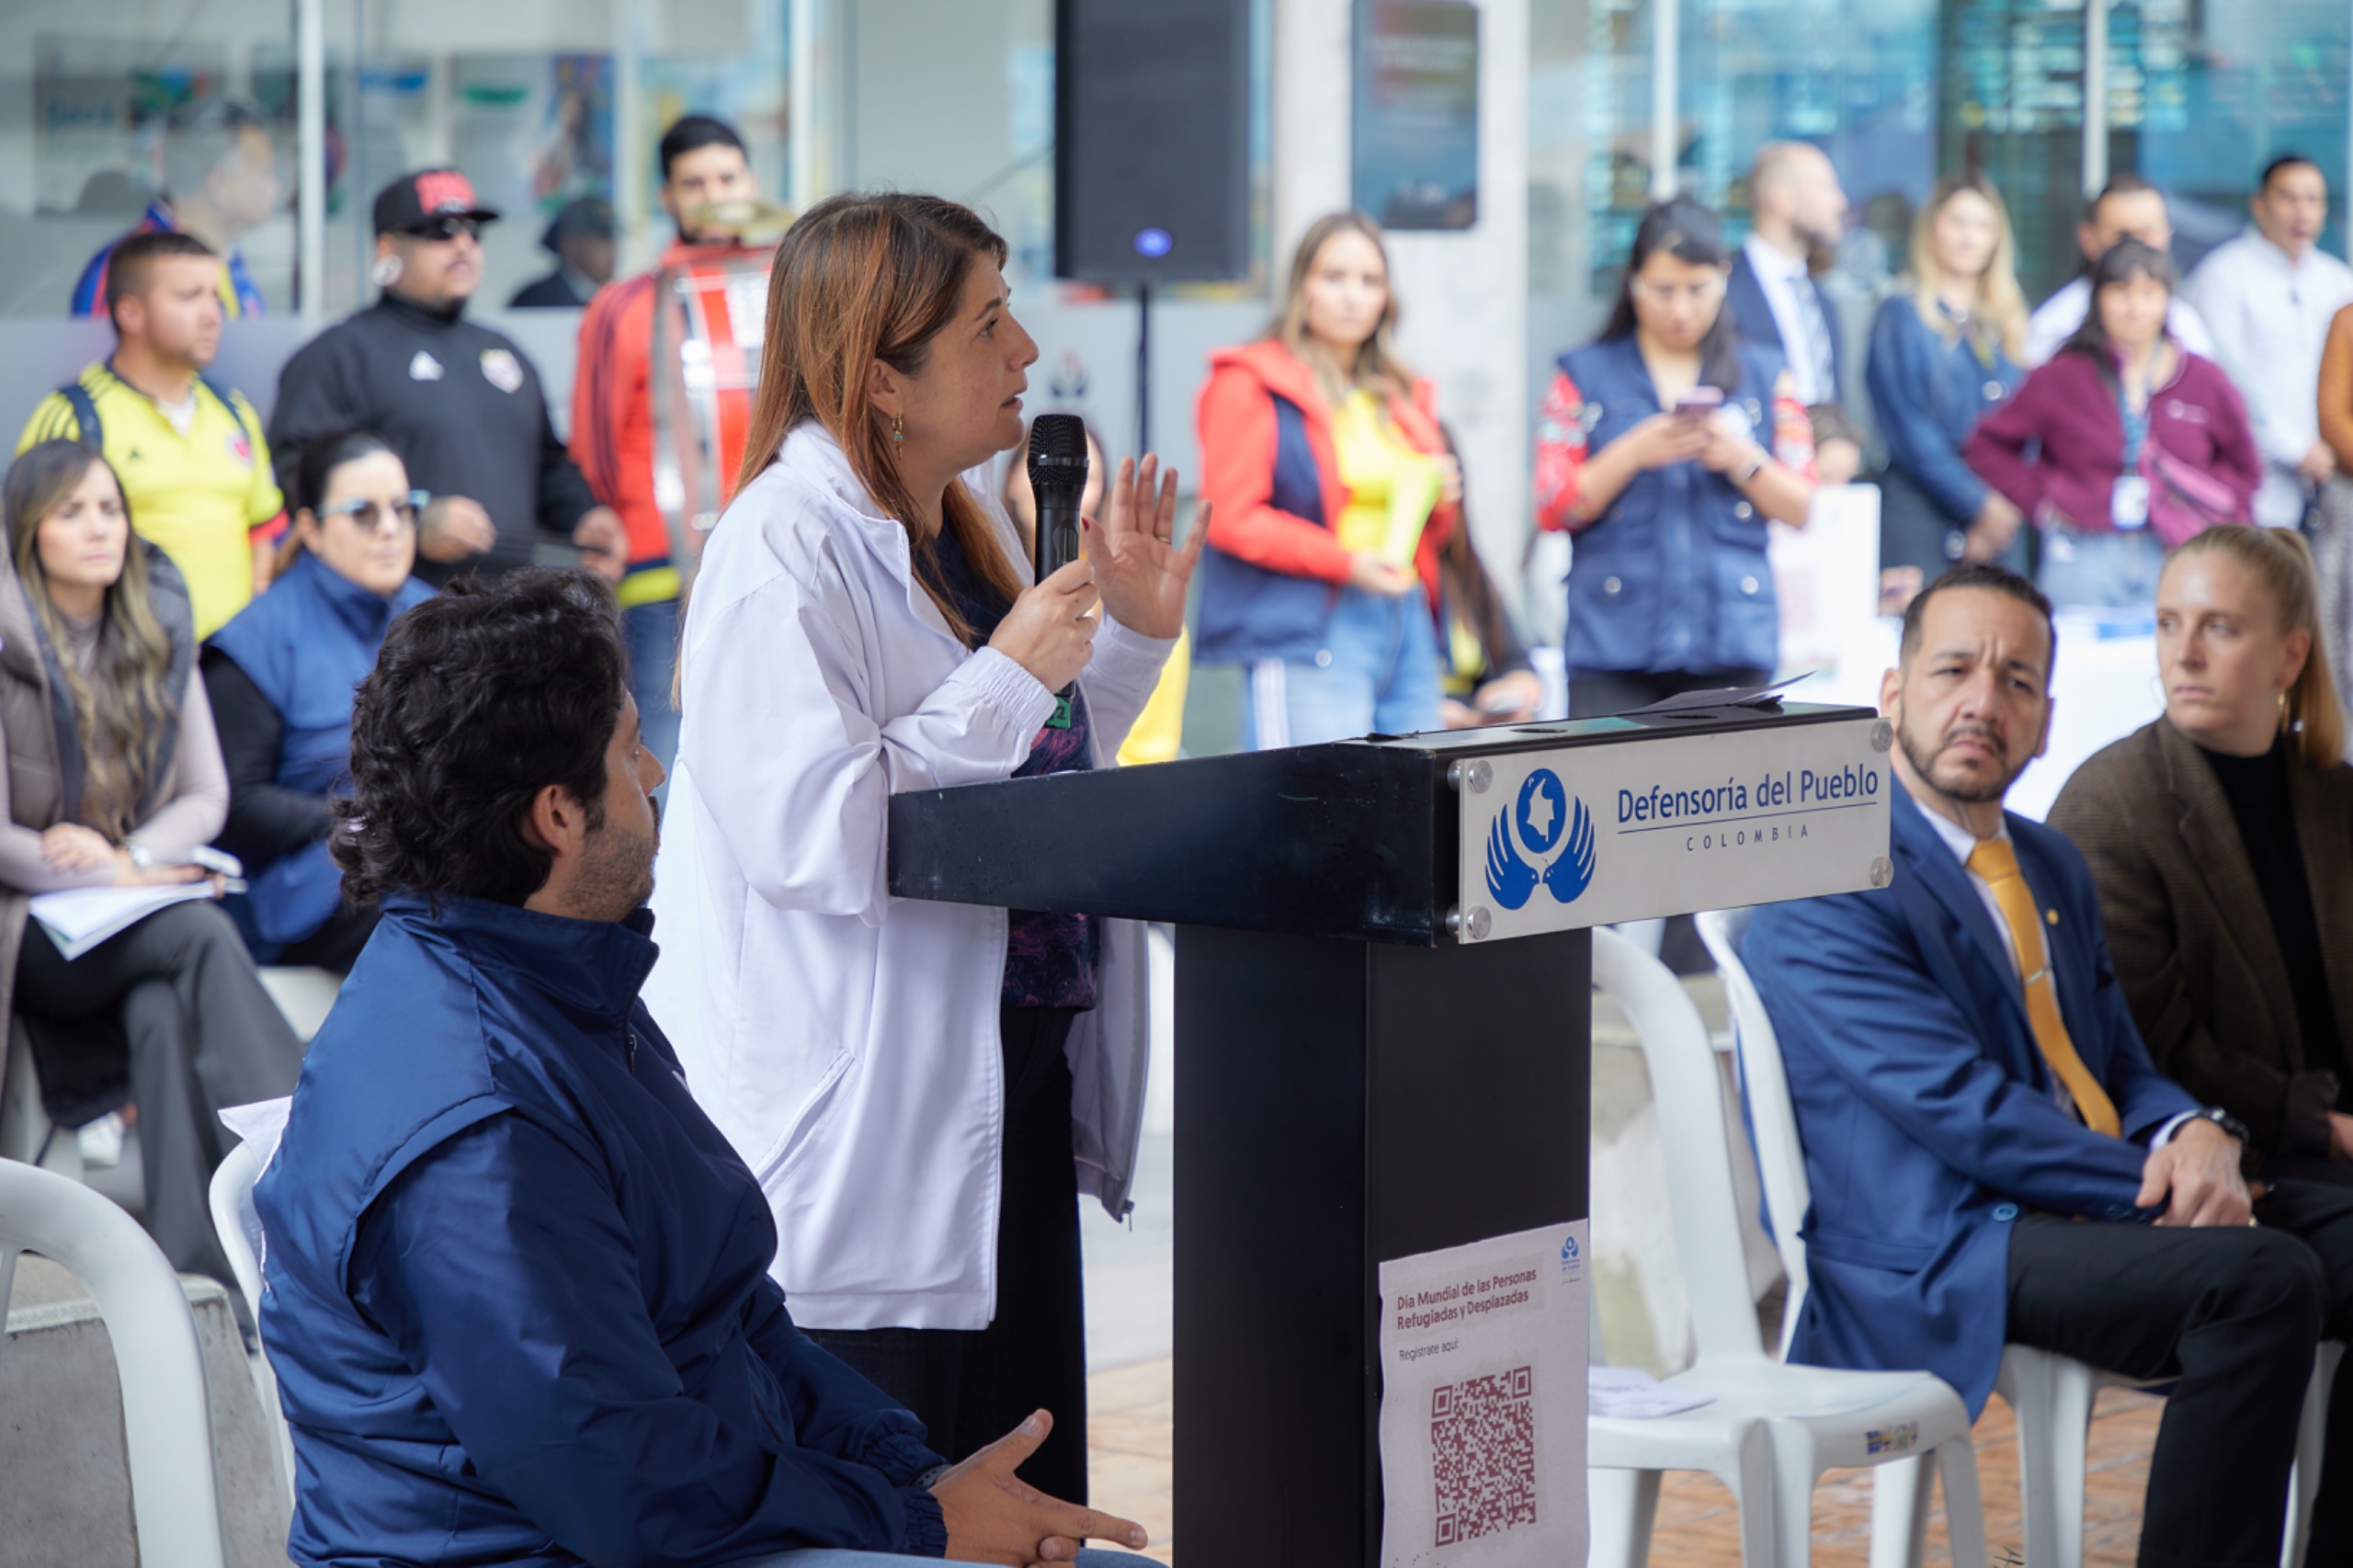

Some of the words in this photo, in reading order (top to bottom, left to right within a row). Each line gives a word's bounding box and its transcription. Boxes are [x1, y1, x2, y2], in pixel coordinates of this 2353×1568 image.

[1618, 778, 1747, 824] Defensoría
[1756, 771, 1792, 808] del
[1801, 763, 1879, 803] Pueblo
[1687, 824, 1808, 851] COLOMBIA
[1417, 1283, 1460, 1306] Mundial
[1461, 1281, 1475, 1297] de
[1477, 1278, 1491, 1293] las
[1493, 1269, 1537, 1290] Personas
[1397, 1306, 1458, 1330] Refugiadas
[1460, 1305, 1466, 1321] y
[1467, 1289, 1529, 1315] Desplazadas
